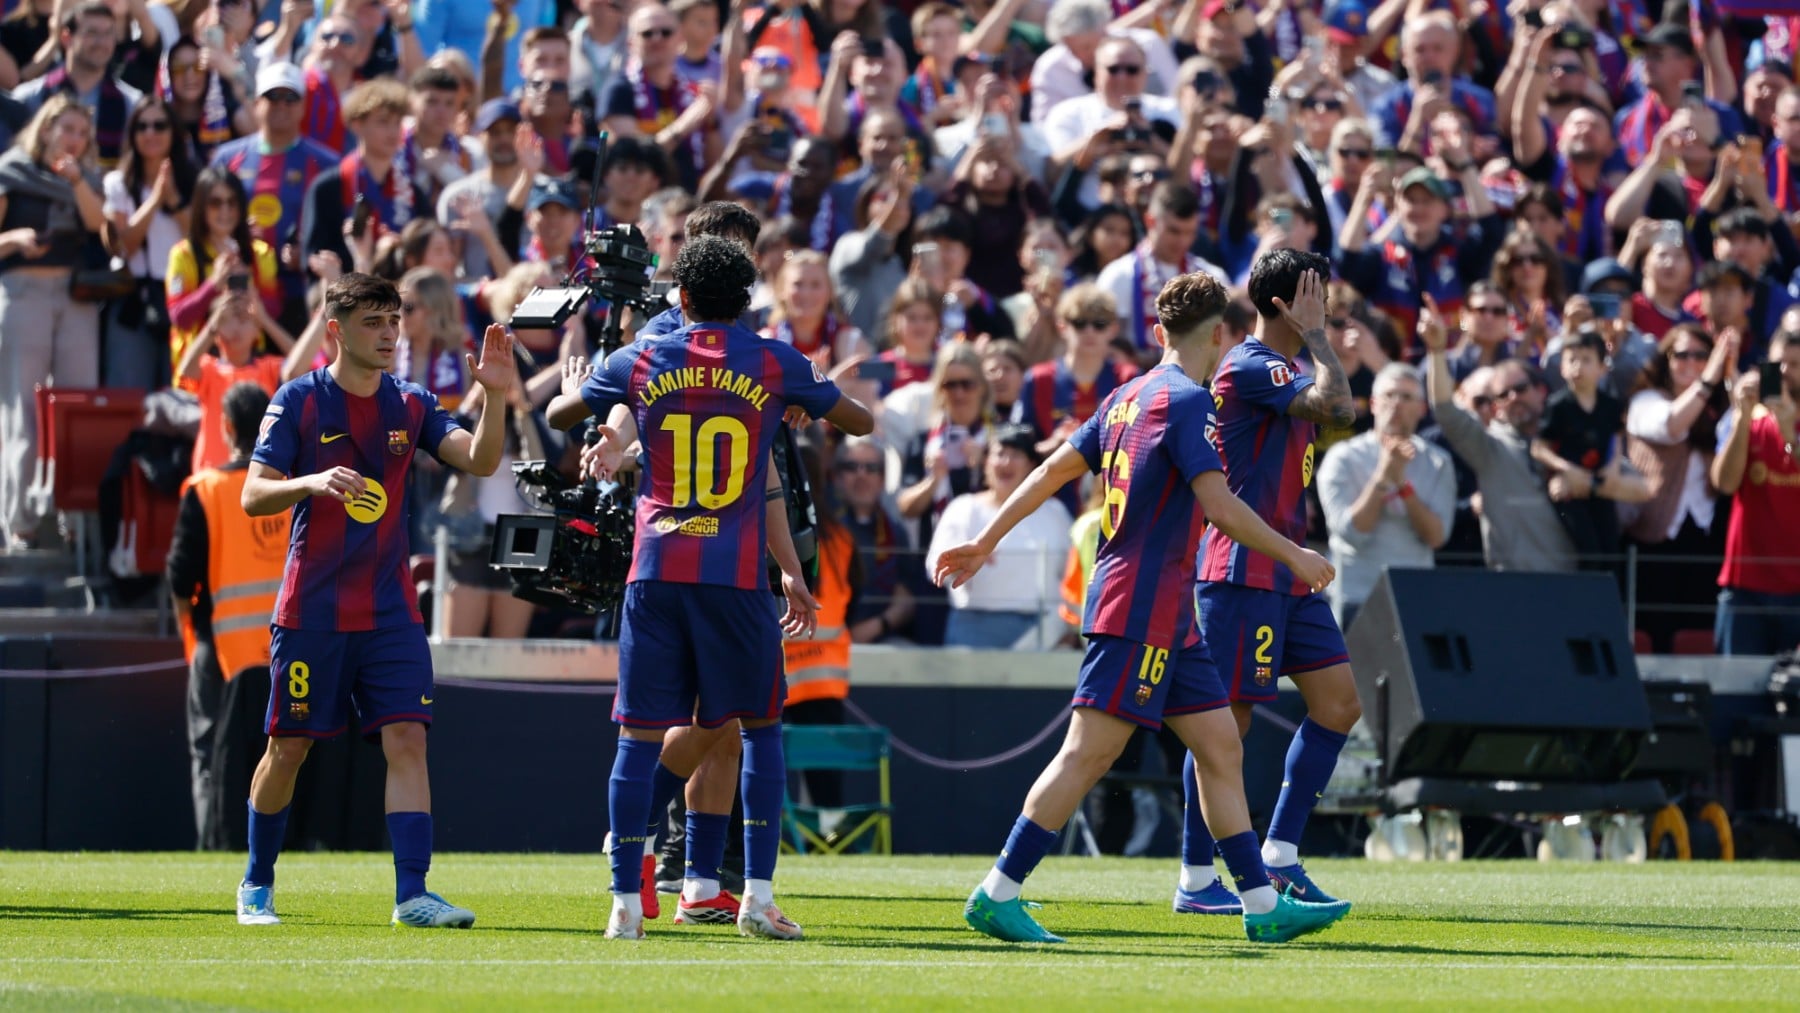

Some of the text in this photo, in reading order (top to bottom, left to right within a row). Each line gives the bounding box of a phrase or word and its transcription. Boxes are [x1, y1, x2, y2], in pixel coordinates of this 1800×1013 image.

[638, 366, 771, 412] LAMINE YAMAL
[660, 413, 749, 510] 10
[679, 522, 719, 534] ACNUR
[1138, 643, 1169, 685] 16
[1255, 625, 1274, 663] 2
[289, 661, 310, 699] 8
